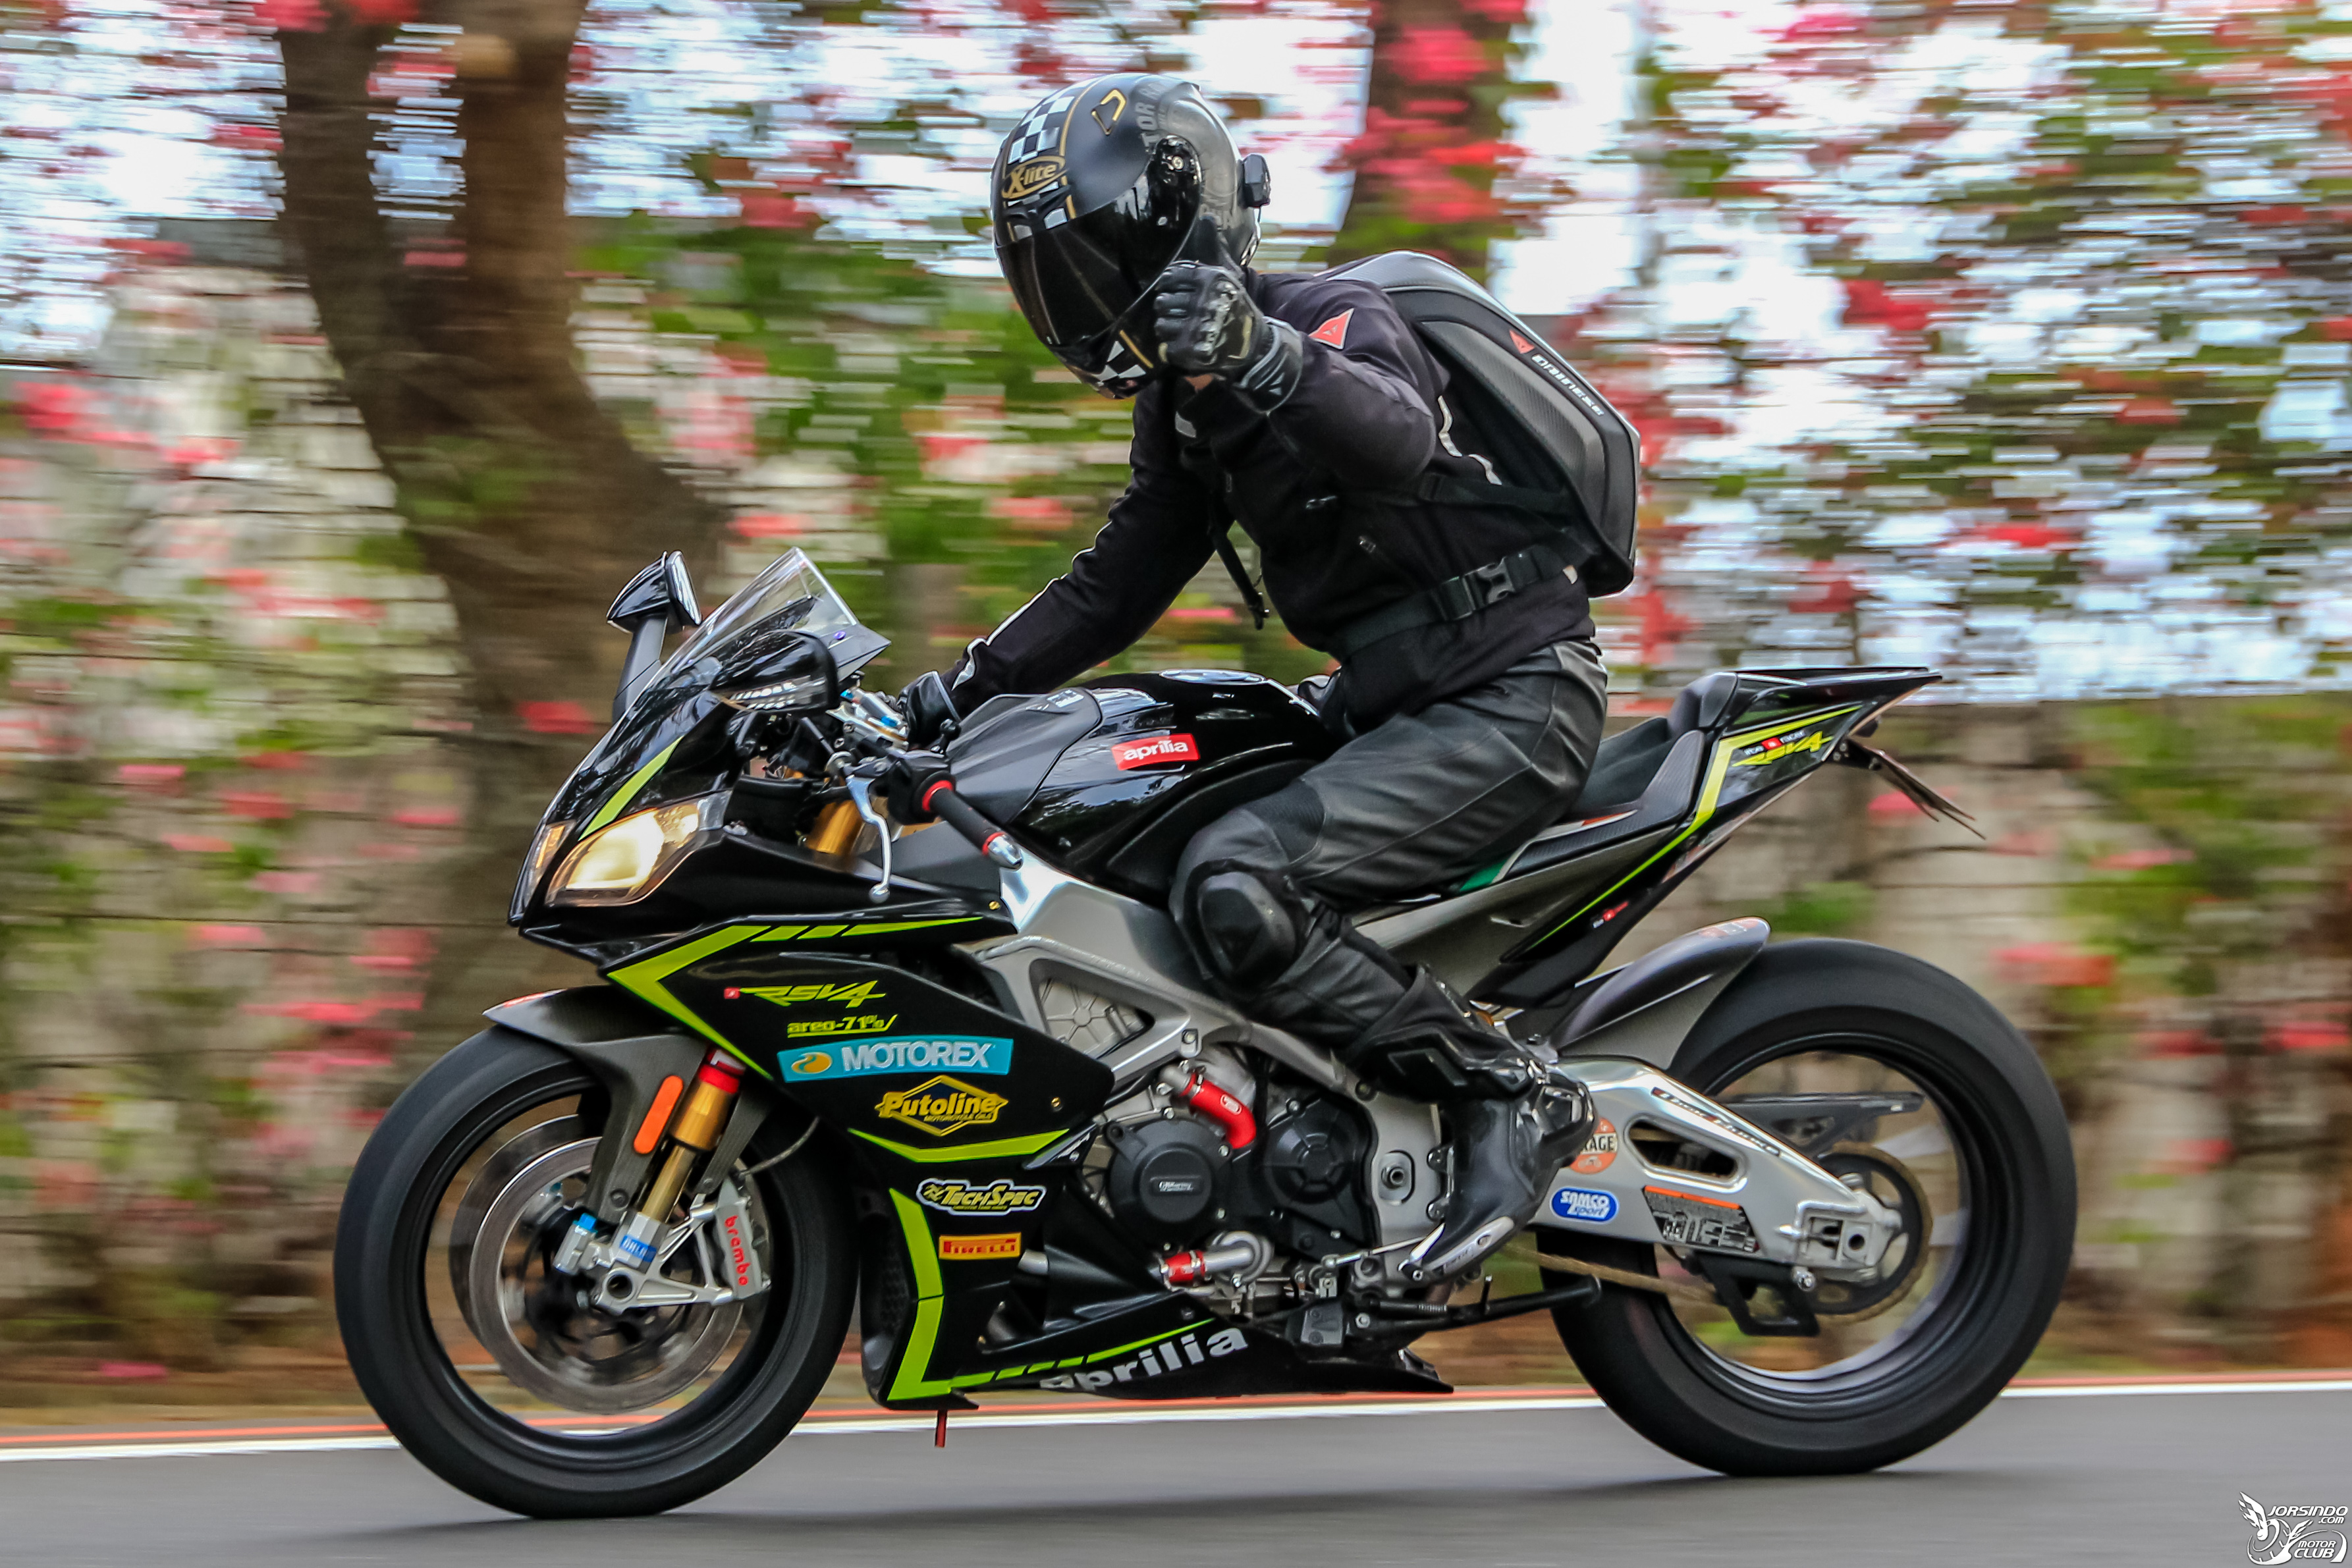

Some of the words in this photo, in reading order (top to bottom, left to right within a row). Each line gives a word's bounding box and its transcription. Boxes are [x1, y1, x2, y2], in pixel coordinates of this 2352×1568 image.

[1007, 165, 1057, 196] X-lite
[1123, 740, 1189, 761] aprilia
[739, 980, 887, 1009] RSV4
[840, 1039, 993, 1071] MOTOREX
[878, 1092, 1000, 1118] Putoline
[725, 1215, 752, 1287] brembo
[1039, 1327, 1248, 1391] aprilia
